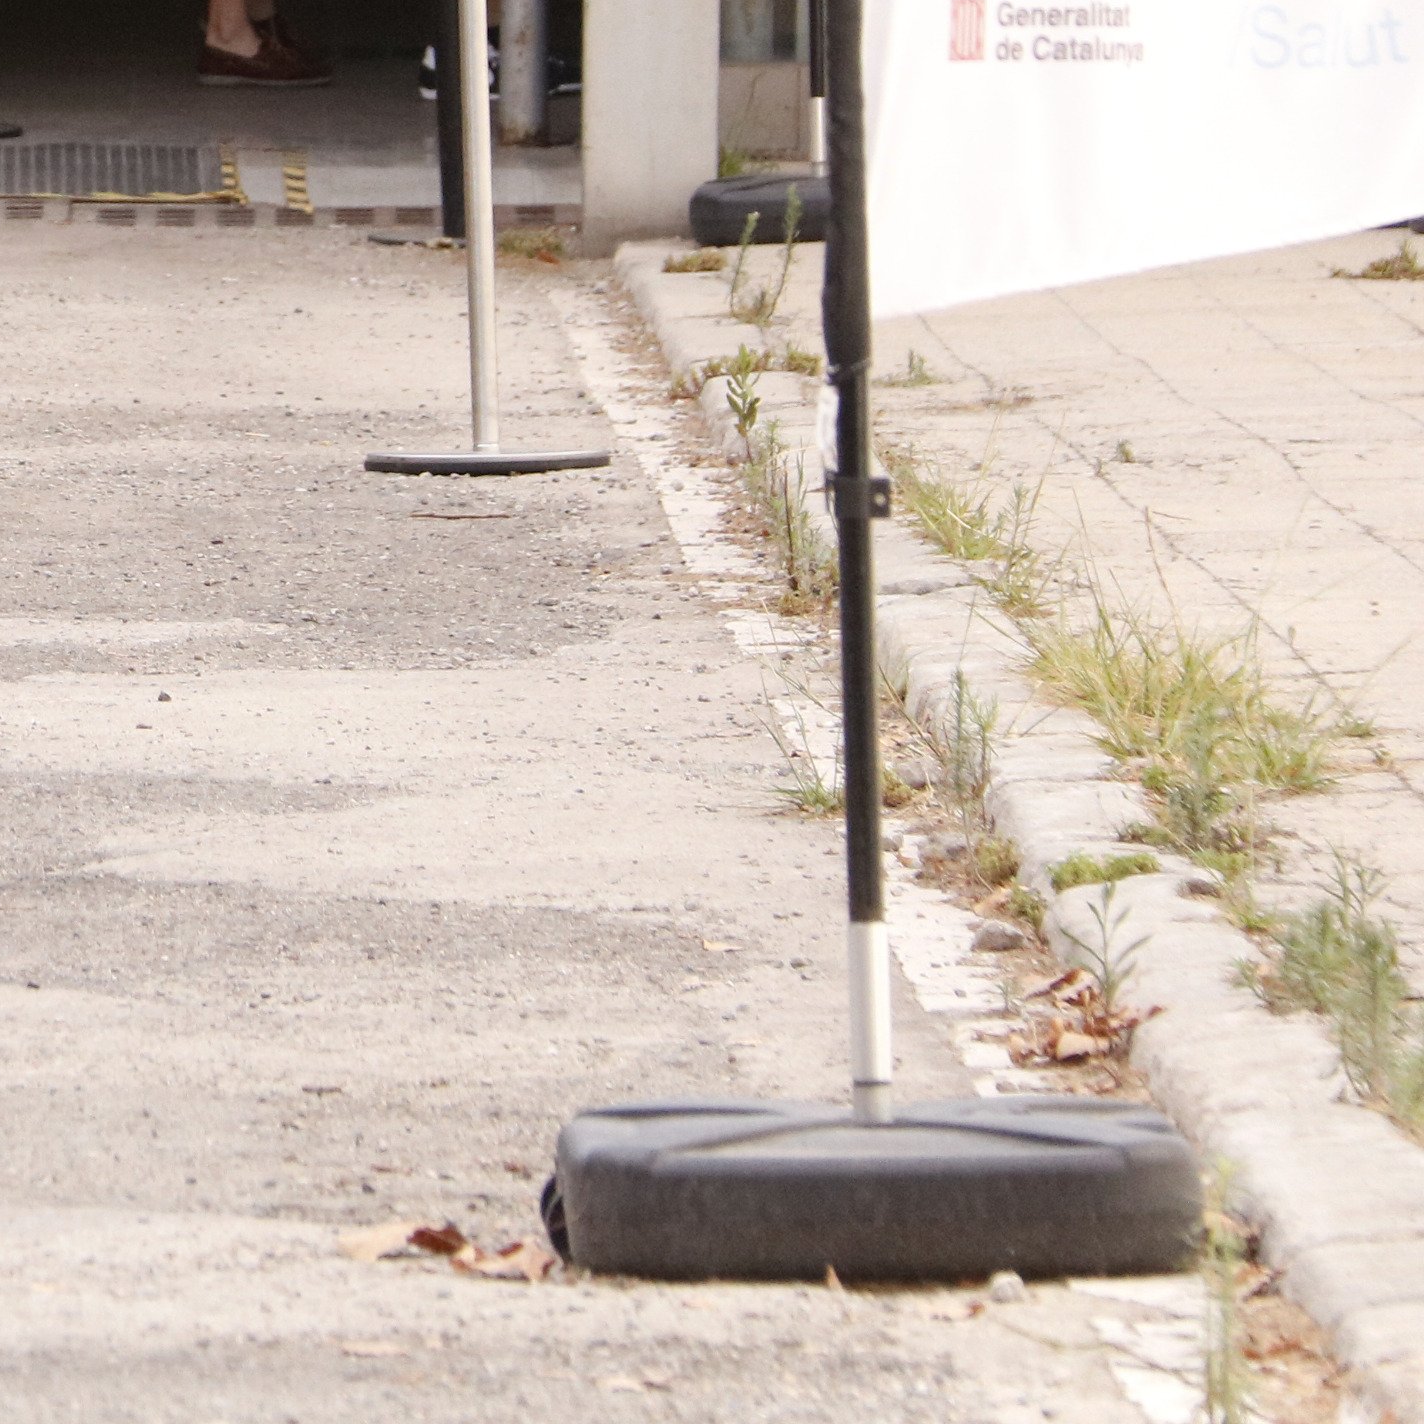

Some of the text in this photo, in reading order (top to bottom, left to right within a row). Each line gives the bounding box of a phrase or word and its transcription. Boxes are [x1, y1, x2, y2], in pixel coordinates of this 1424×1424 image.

[996, 0, 1131, 28] Generalitat
[995, 36, 1144, 68] de Catalunya
